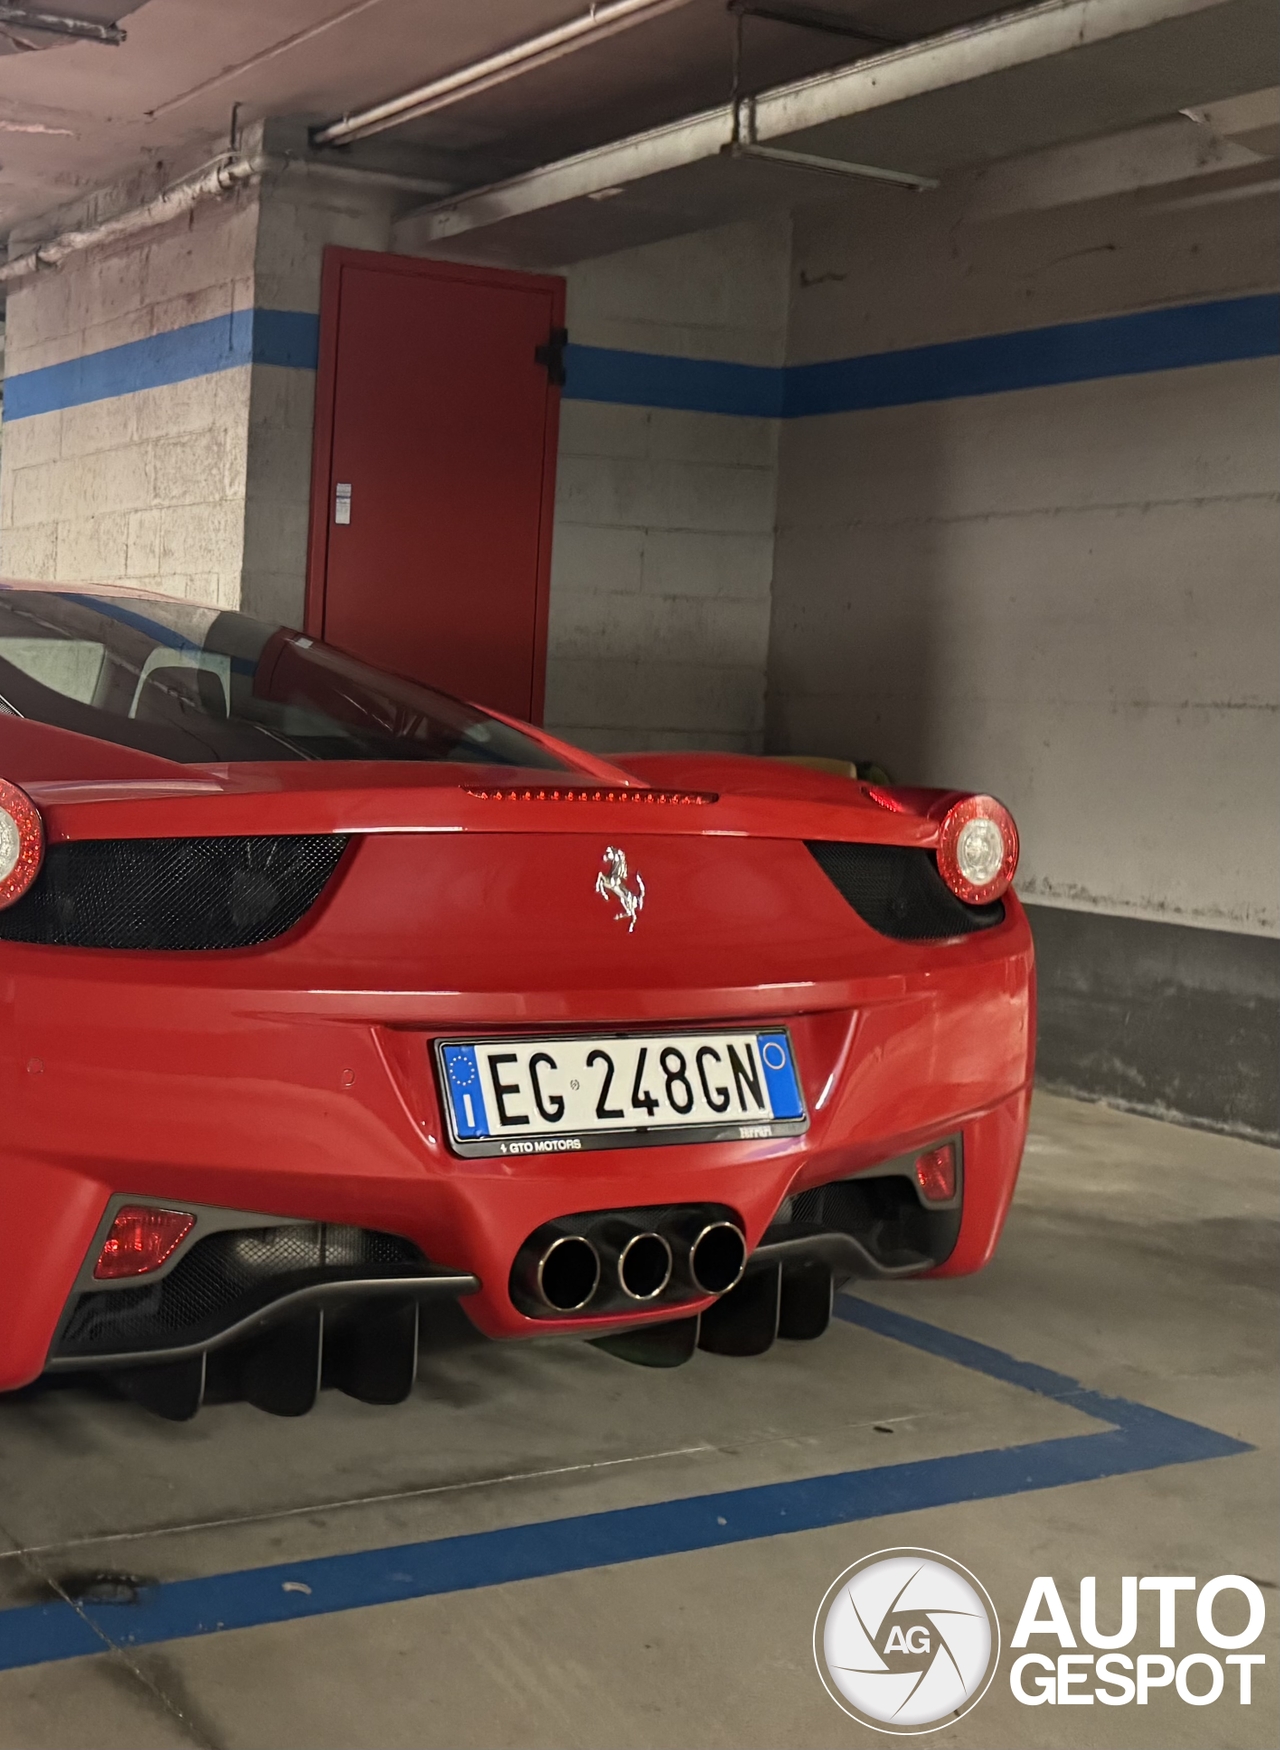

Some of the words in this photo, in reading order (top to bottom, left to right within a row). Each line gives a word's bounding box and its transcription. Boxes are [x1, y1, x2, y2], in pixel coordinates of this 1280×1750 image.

[487, 1051, 565, 1127] EG
[586, 1043, 766, 1120] 248GN
[509, 1142, 533, 1154] GTO
[534, 1139, 581, 1152] MOTORS
